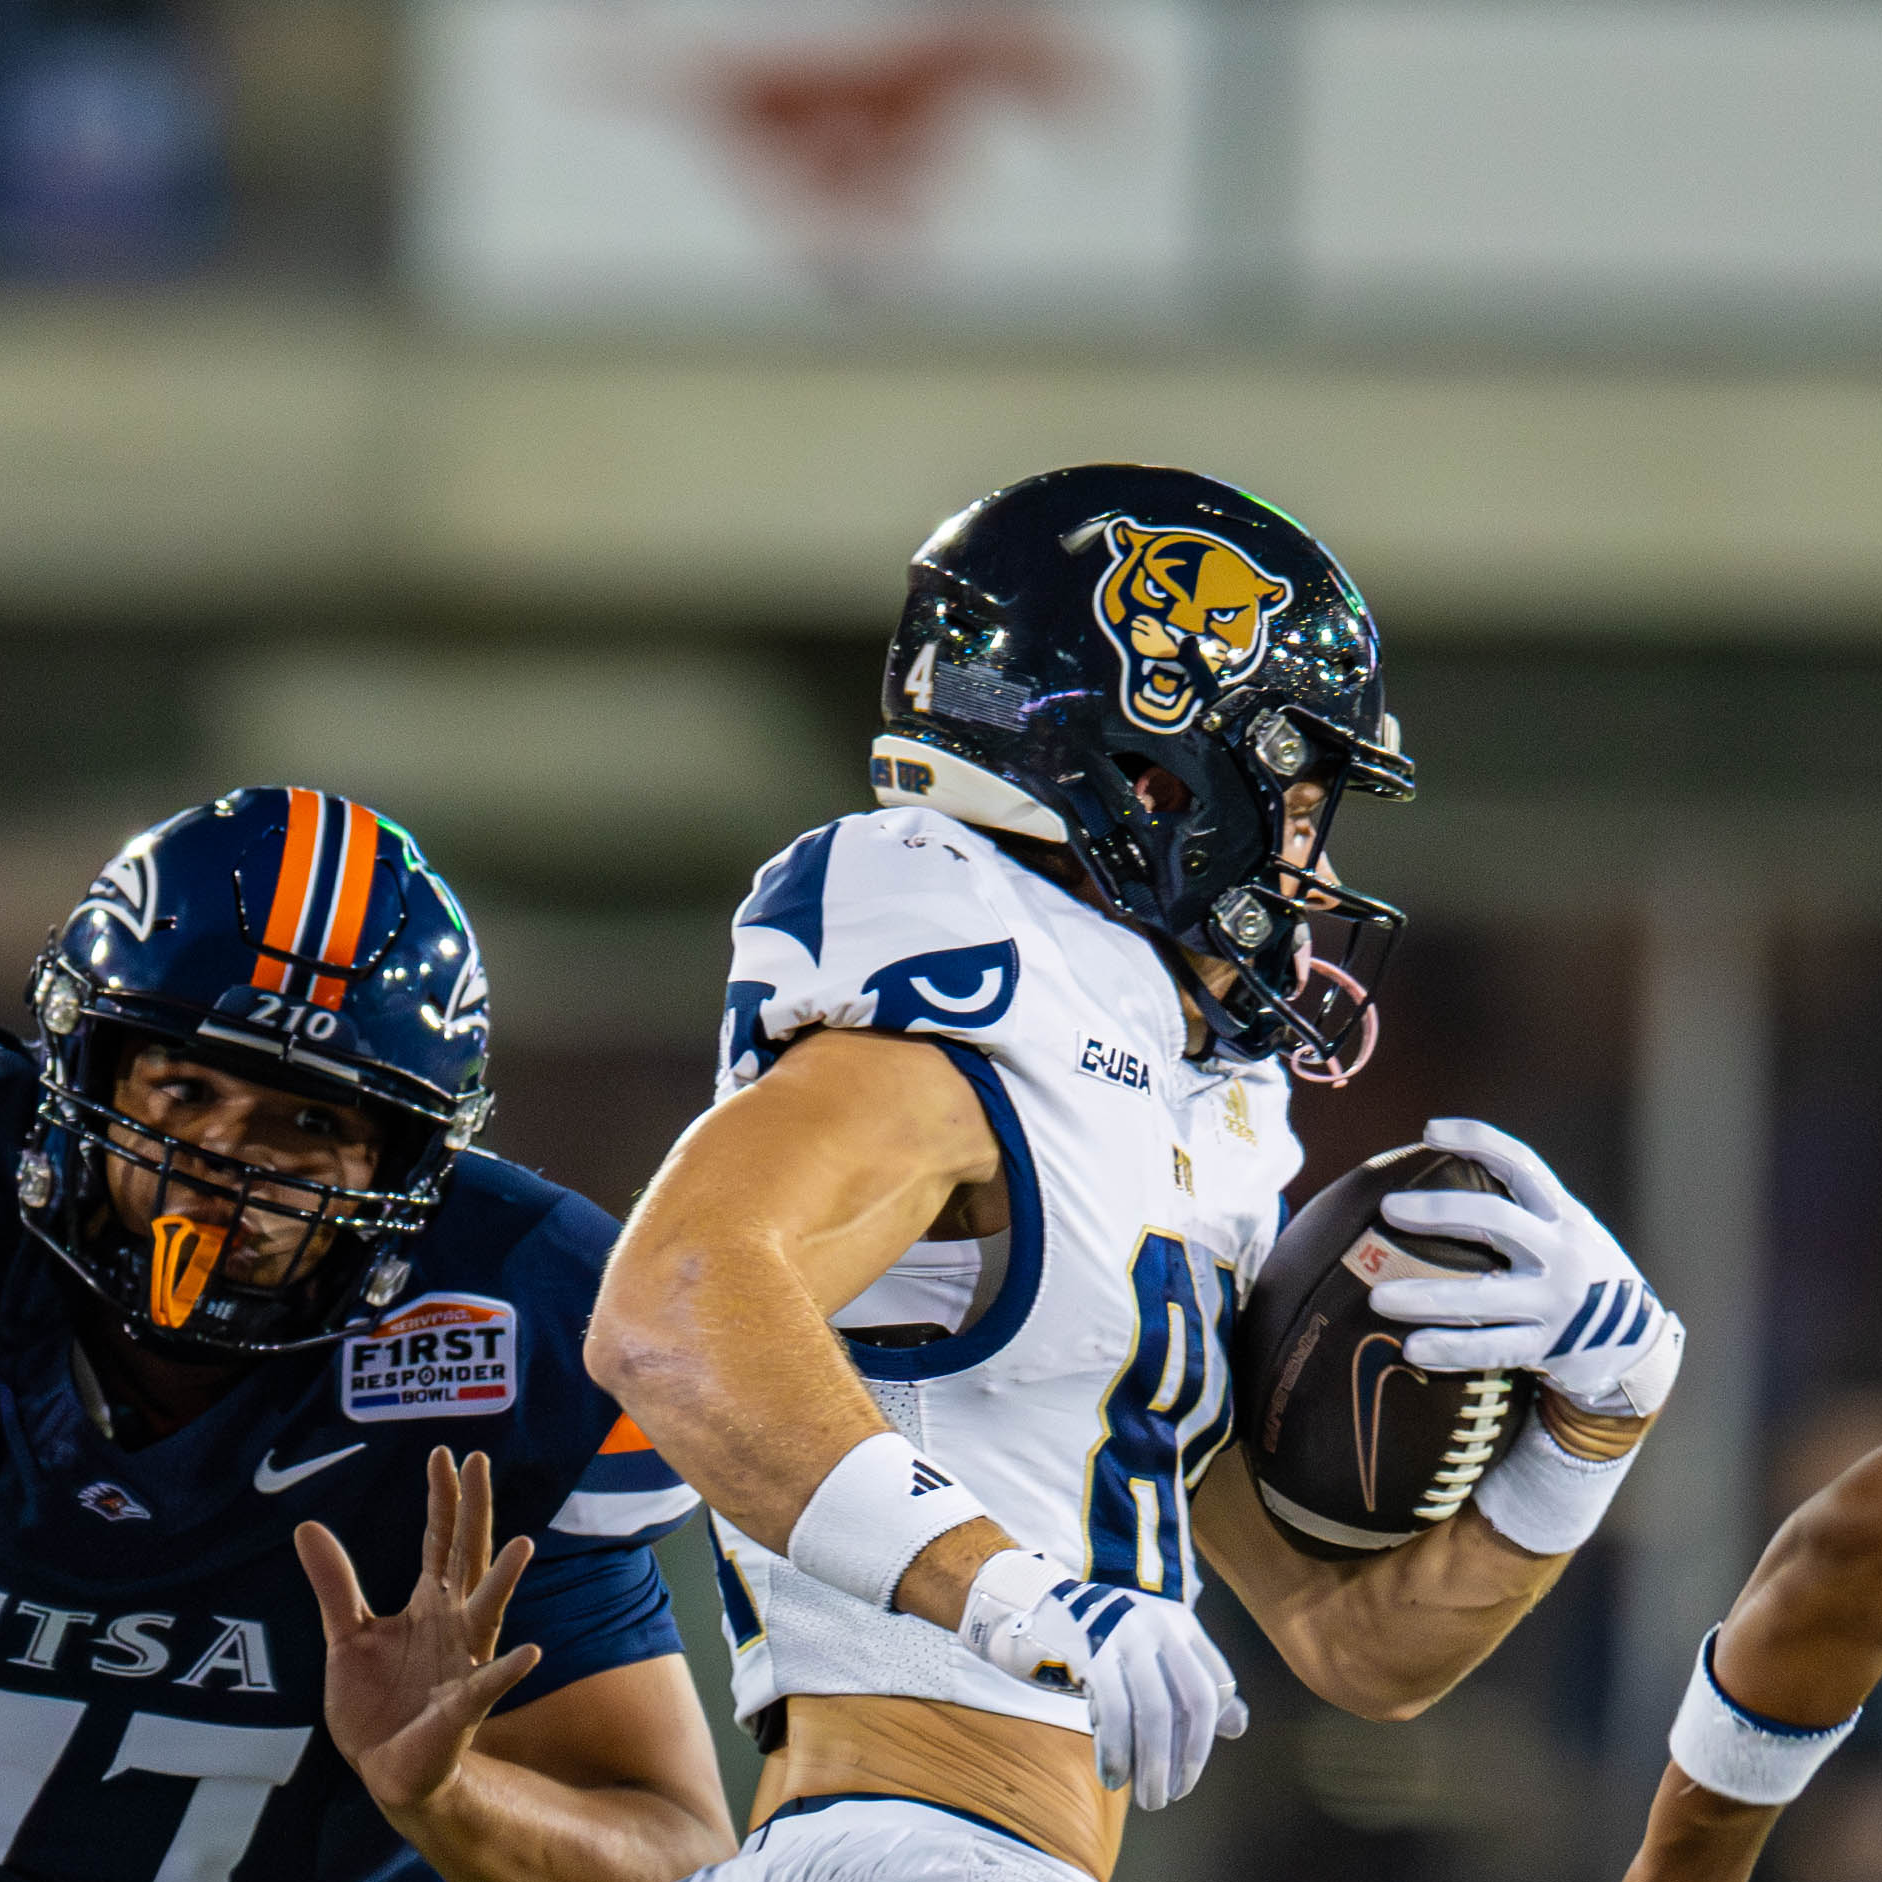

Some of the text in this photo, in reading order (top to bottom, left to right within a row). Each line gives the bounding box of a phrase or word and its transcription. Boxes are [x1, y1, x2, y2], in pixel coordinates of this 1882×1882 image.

[903, 641, 938, 714] 4
[246, 993, 338, 1041] 210
[350, 1363, 506, 1392] RESPONDER
[400, 1387, 457, 1405] BOWL
